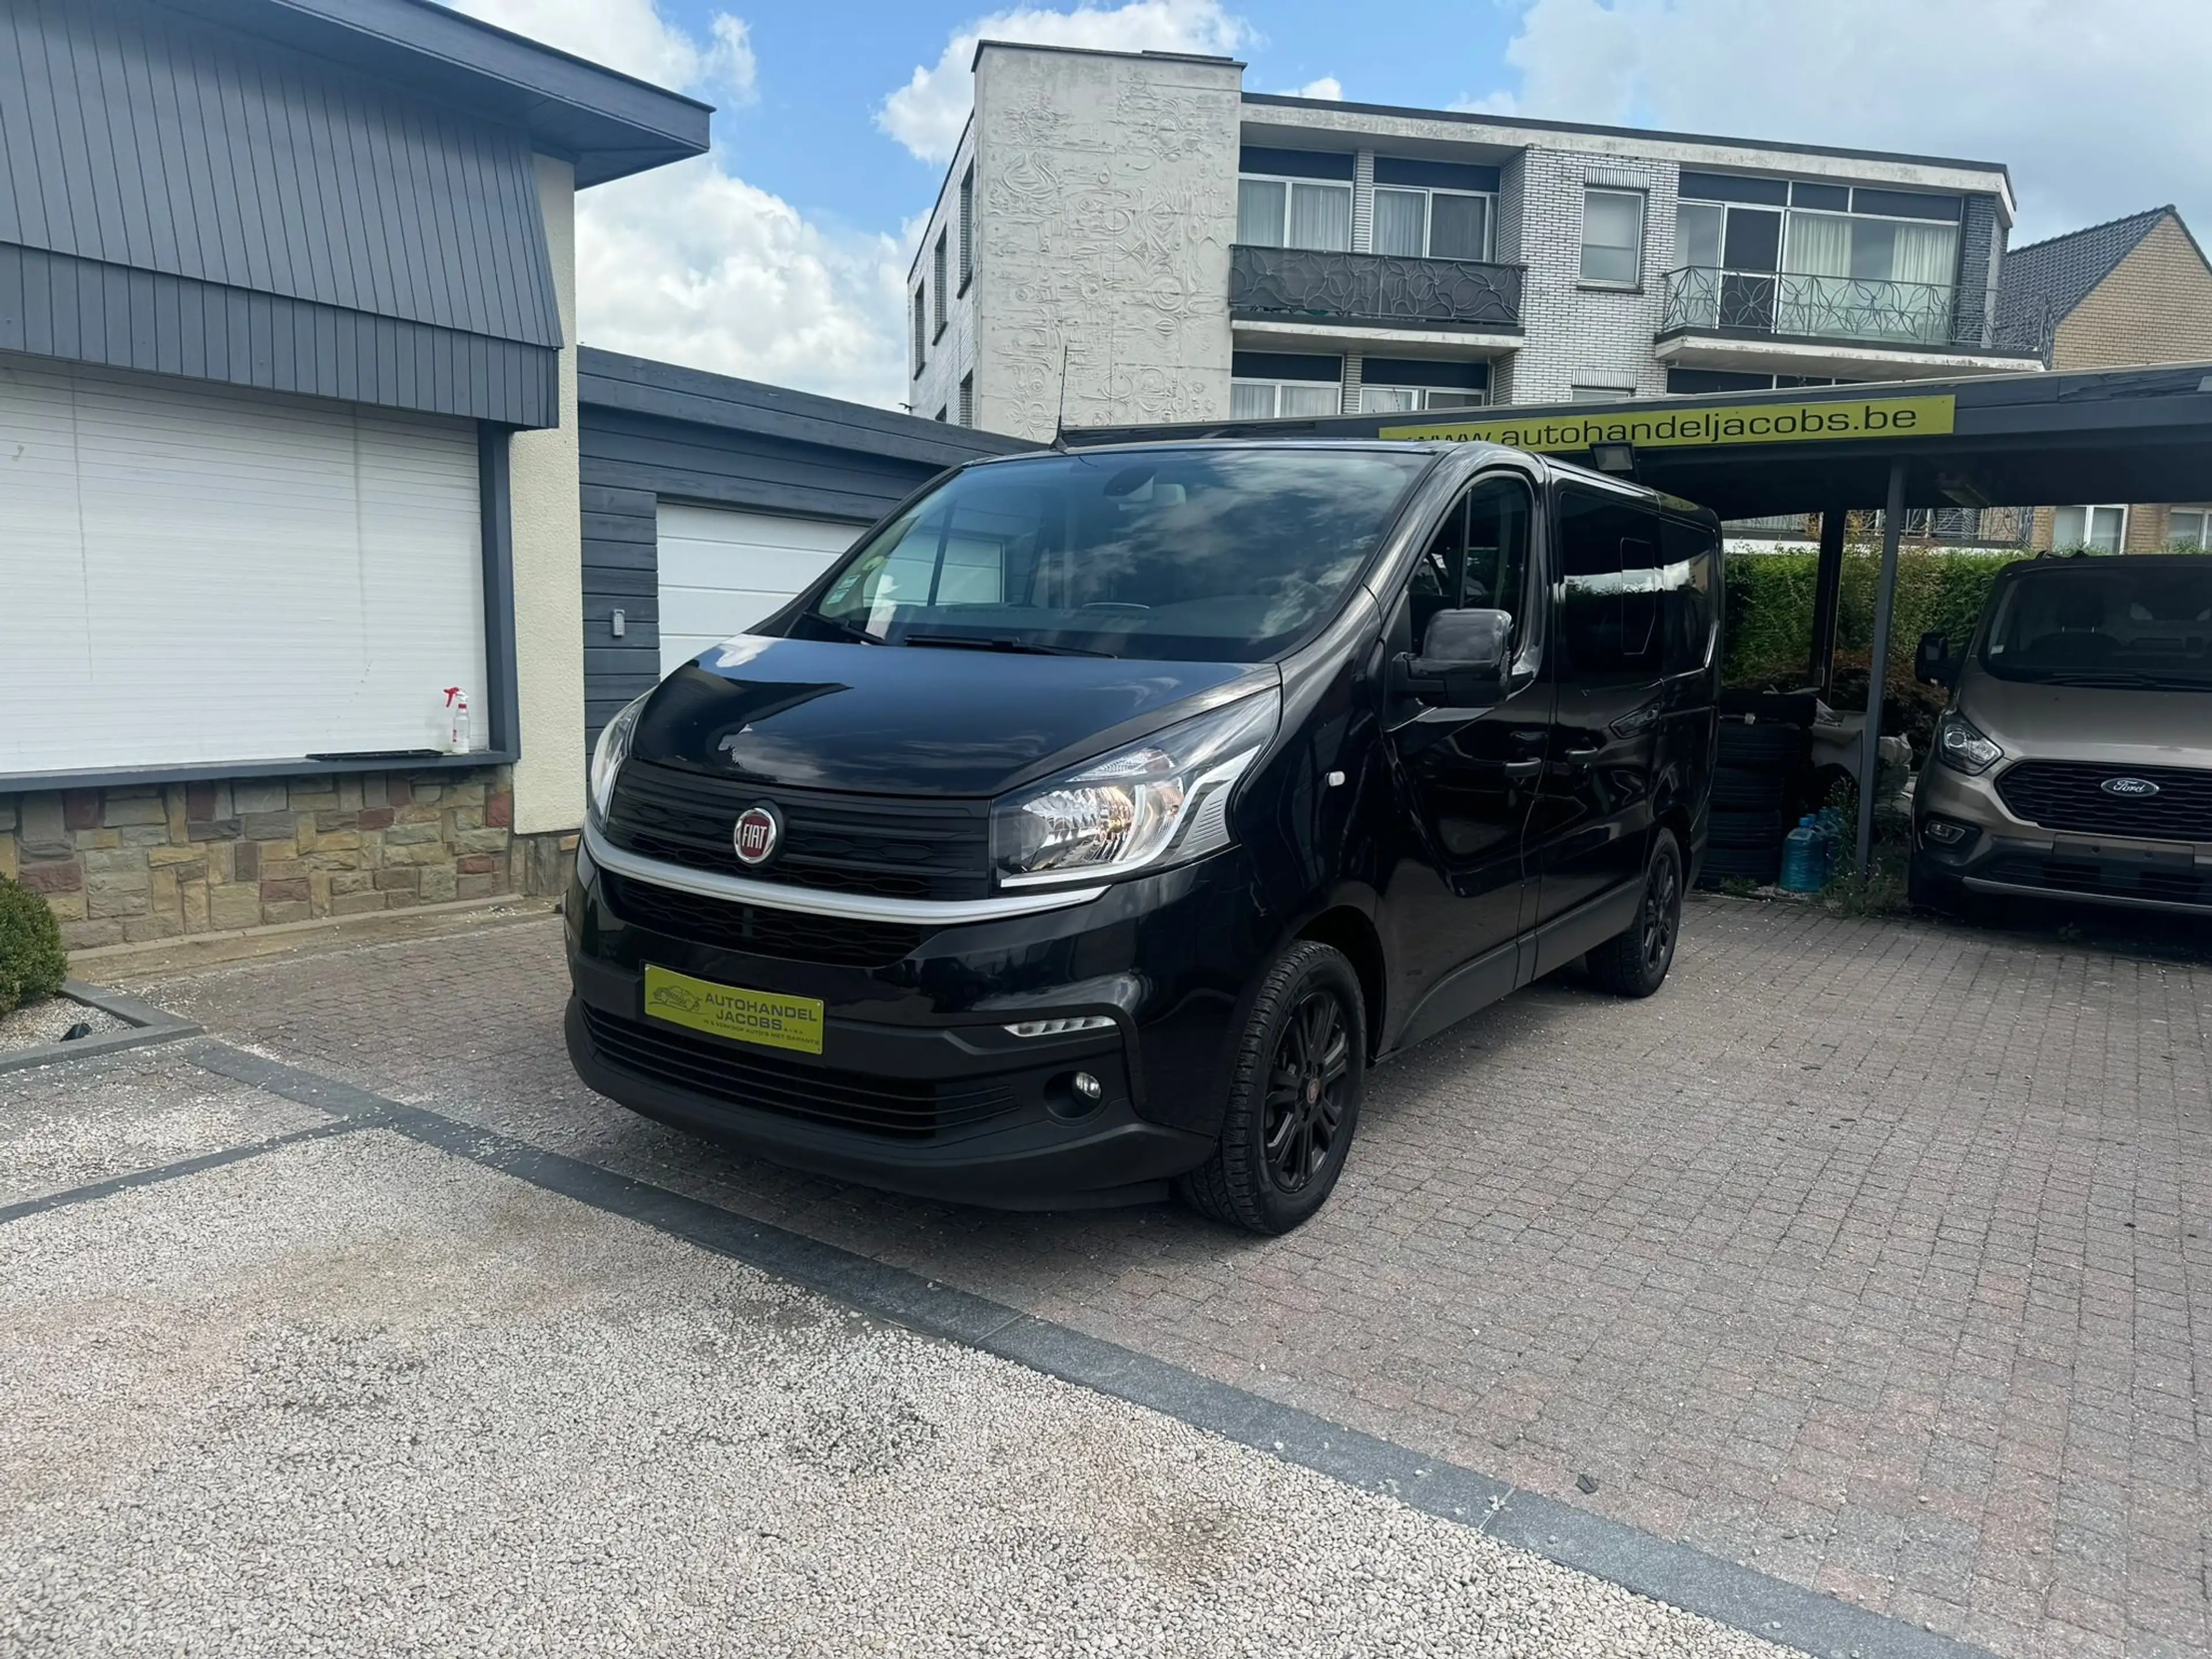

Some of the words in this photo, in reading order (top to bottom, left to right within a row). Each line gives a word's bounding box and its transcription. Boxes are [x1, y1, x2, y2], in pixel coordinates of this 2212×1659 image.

[1406, 405, 1917, 446] wautohandeljacobs.be
[2113, 780, 2145, 793] Ford
[742, 824, 767, 849] FIAT
[705, 993, 817, 1022] AUTOHANDEL
[716, 1009, 783, 1031] JACOBS
